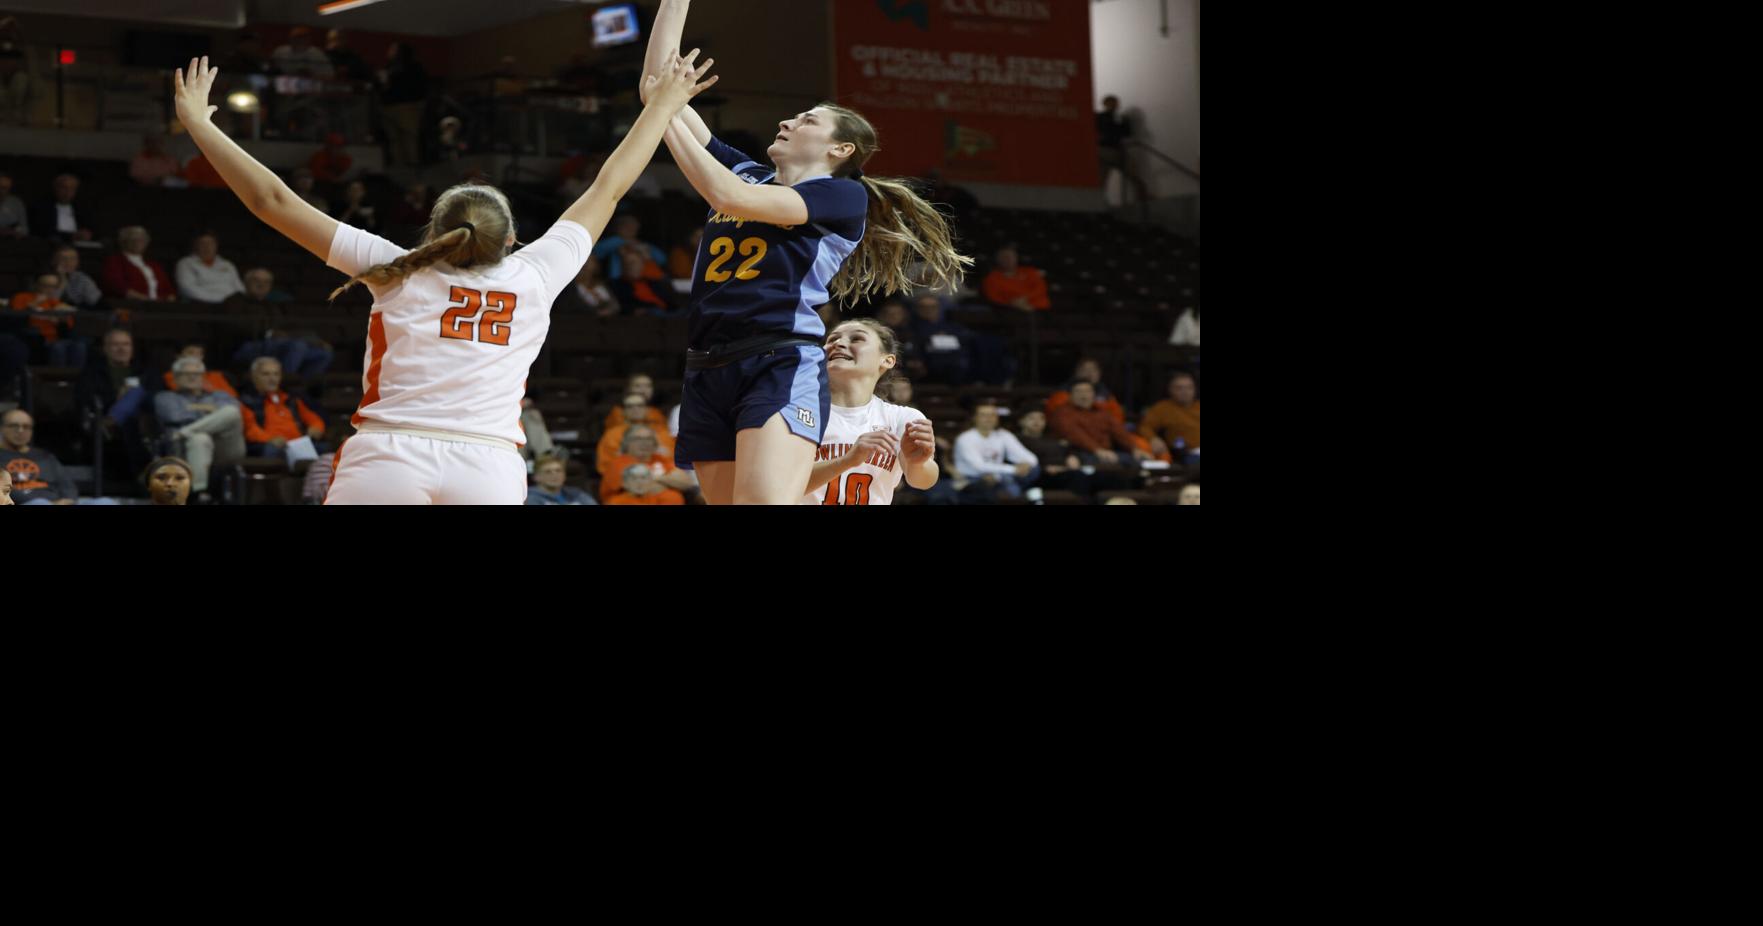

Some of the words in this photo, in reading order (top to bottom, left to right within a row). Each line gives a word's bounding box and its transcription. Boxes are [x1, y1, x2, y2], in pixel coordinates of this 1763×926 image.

[850, 44, 943, 66] OFFICIAL
[948, 51, 1001, 71] REAL
[1006, 55, 1079, 76] ESTATE
[880, 63, 974, 84] HOUSING
[977, 70, 1070, 89] PARTNER
[705, 236, 767, 282] 22
[440, 285, 517, 346] 22
[821, 472, 874, 506] 10
